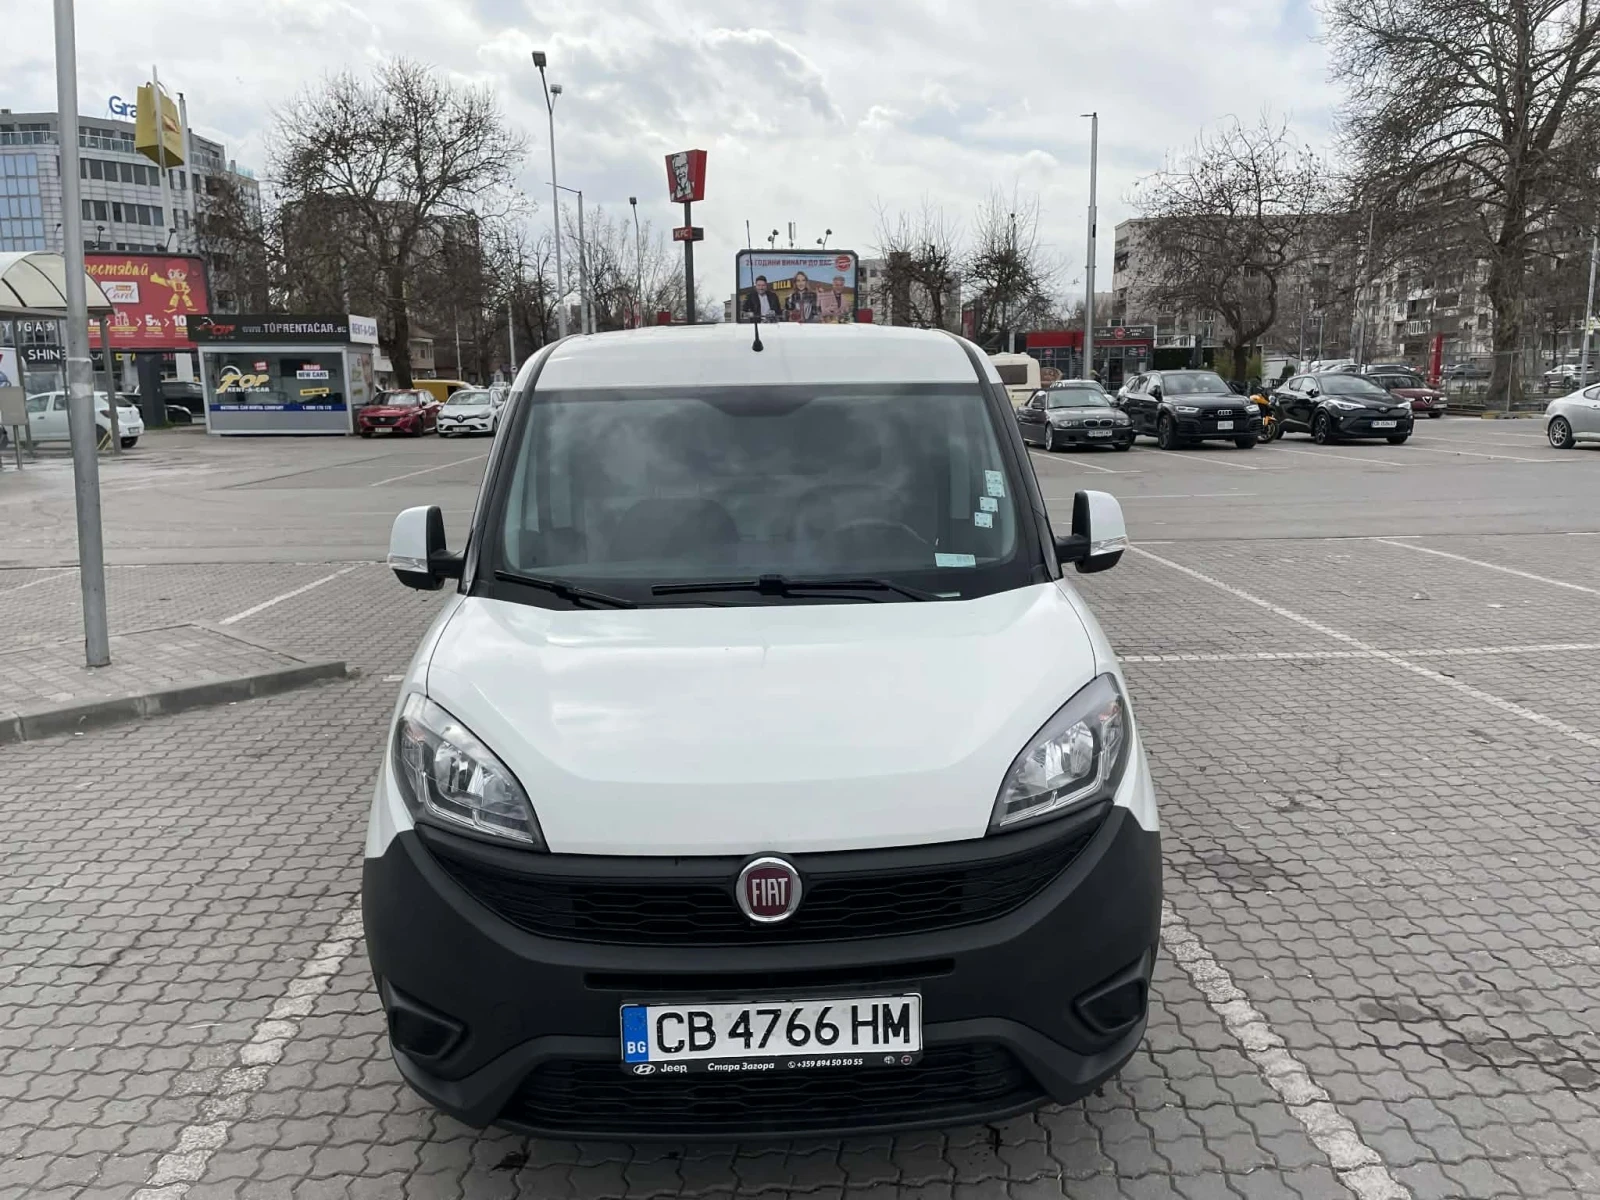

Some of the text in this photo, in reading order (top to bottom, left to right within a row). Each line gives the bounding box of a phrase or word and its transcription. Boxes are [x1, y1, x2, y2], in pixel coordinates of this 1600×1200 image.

[674, 229, 689, 238] KFC
[755, 259, 779, 267] ГОДИНИ
[782, 259, 807, 267] ВИНАГИ
[808, 259, 819, 267] ДО
[772, 280, 792, 290] BILLA
[145, 314, 162, 327] 5%
[215, 374, 270, 394] TOP
[752, 877, 788, 907] FIAT
[728, 1006, 840, 1050] 4766
[627, 1041, 647, 1054] BG
[661, 1063, 688, 1073] Jeep
[707, 1062, 775, 1072] Стара Загора
[797, 1060, 815, 1068] +359
[816, 1059, 831, 1067] 894
[842, 1058, 852, 1066] 50
